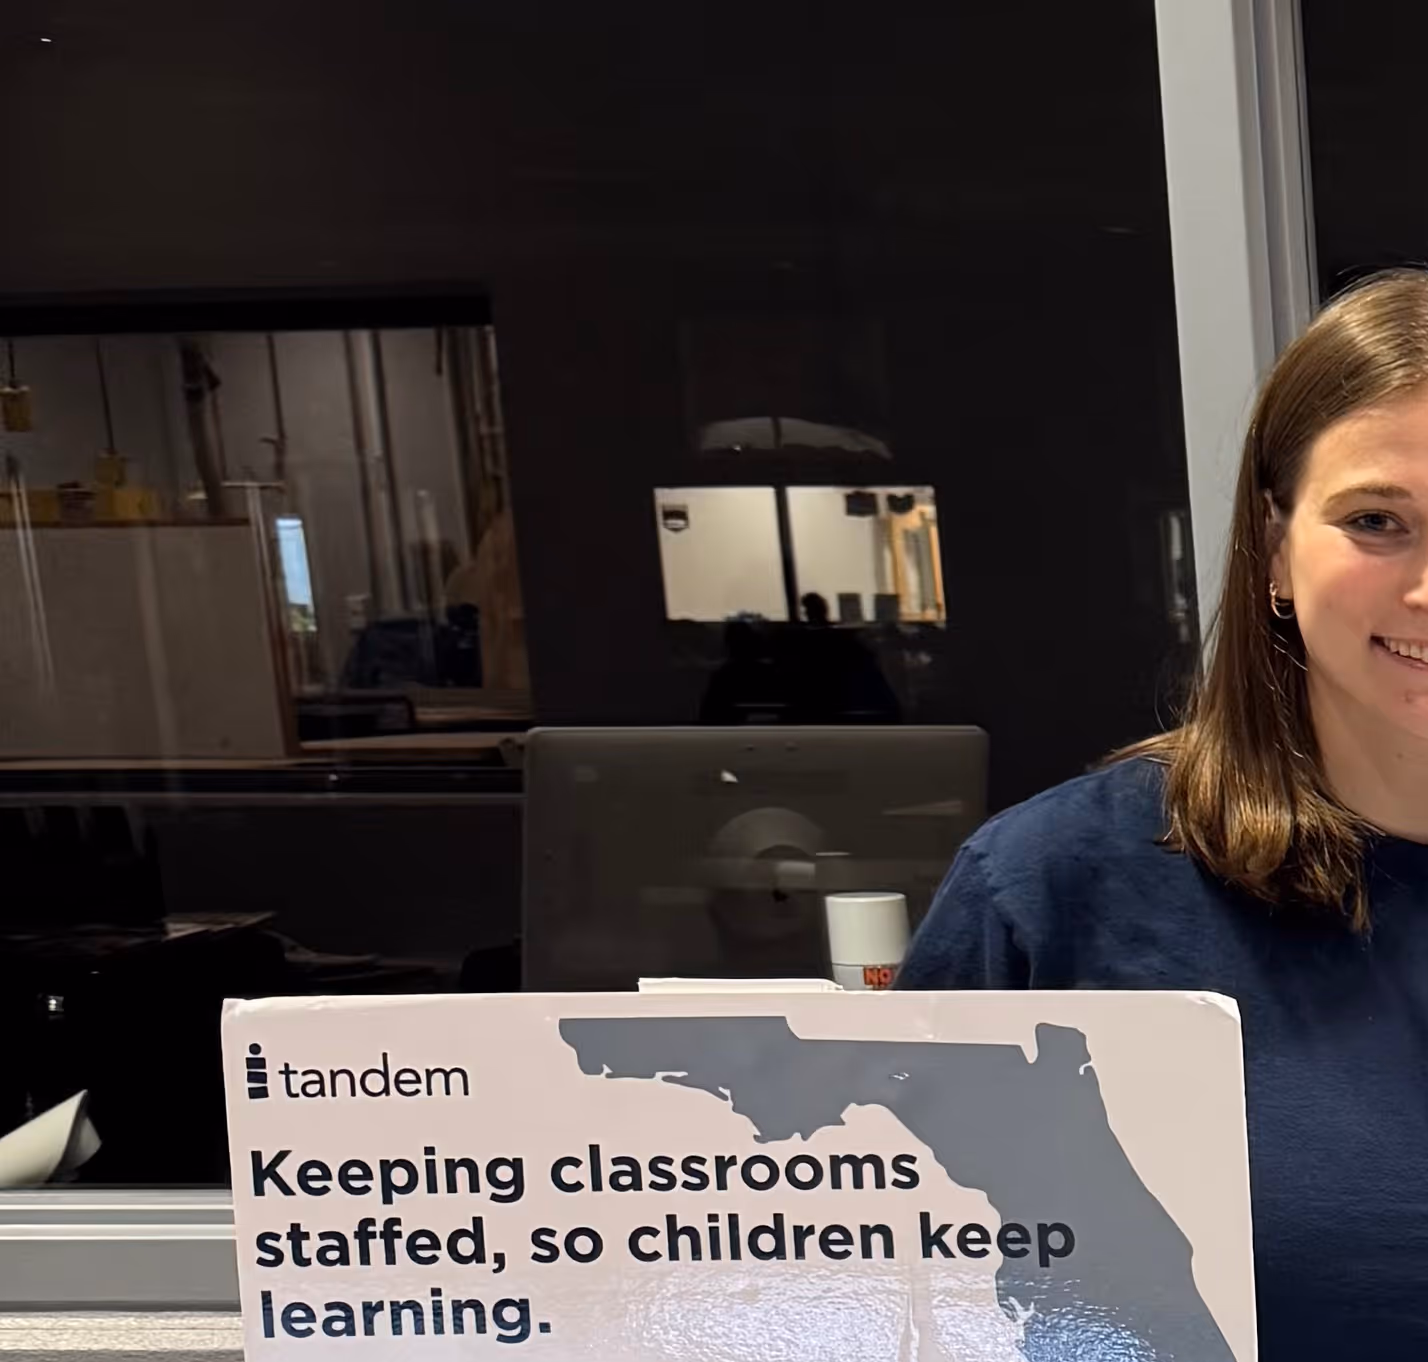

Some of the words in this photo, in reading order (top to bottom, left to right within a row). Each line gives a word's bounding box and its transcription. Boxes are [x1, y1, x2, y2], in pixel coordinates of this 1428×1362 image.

[279, 1052, 469, 1098] tandem
[251, 1147, 524, 1204] Keeping
[551, 1144, 919, 1192] classrooms
[256, 1217, 505, 1273] staffed,
[531, 1227, 603, 1263] so
[629, 1213, 894, 1262] children
[920, 1212, 1075, 1268] keep
[261, 1291, 551, 1343] learning.
